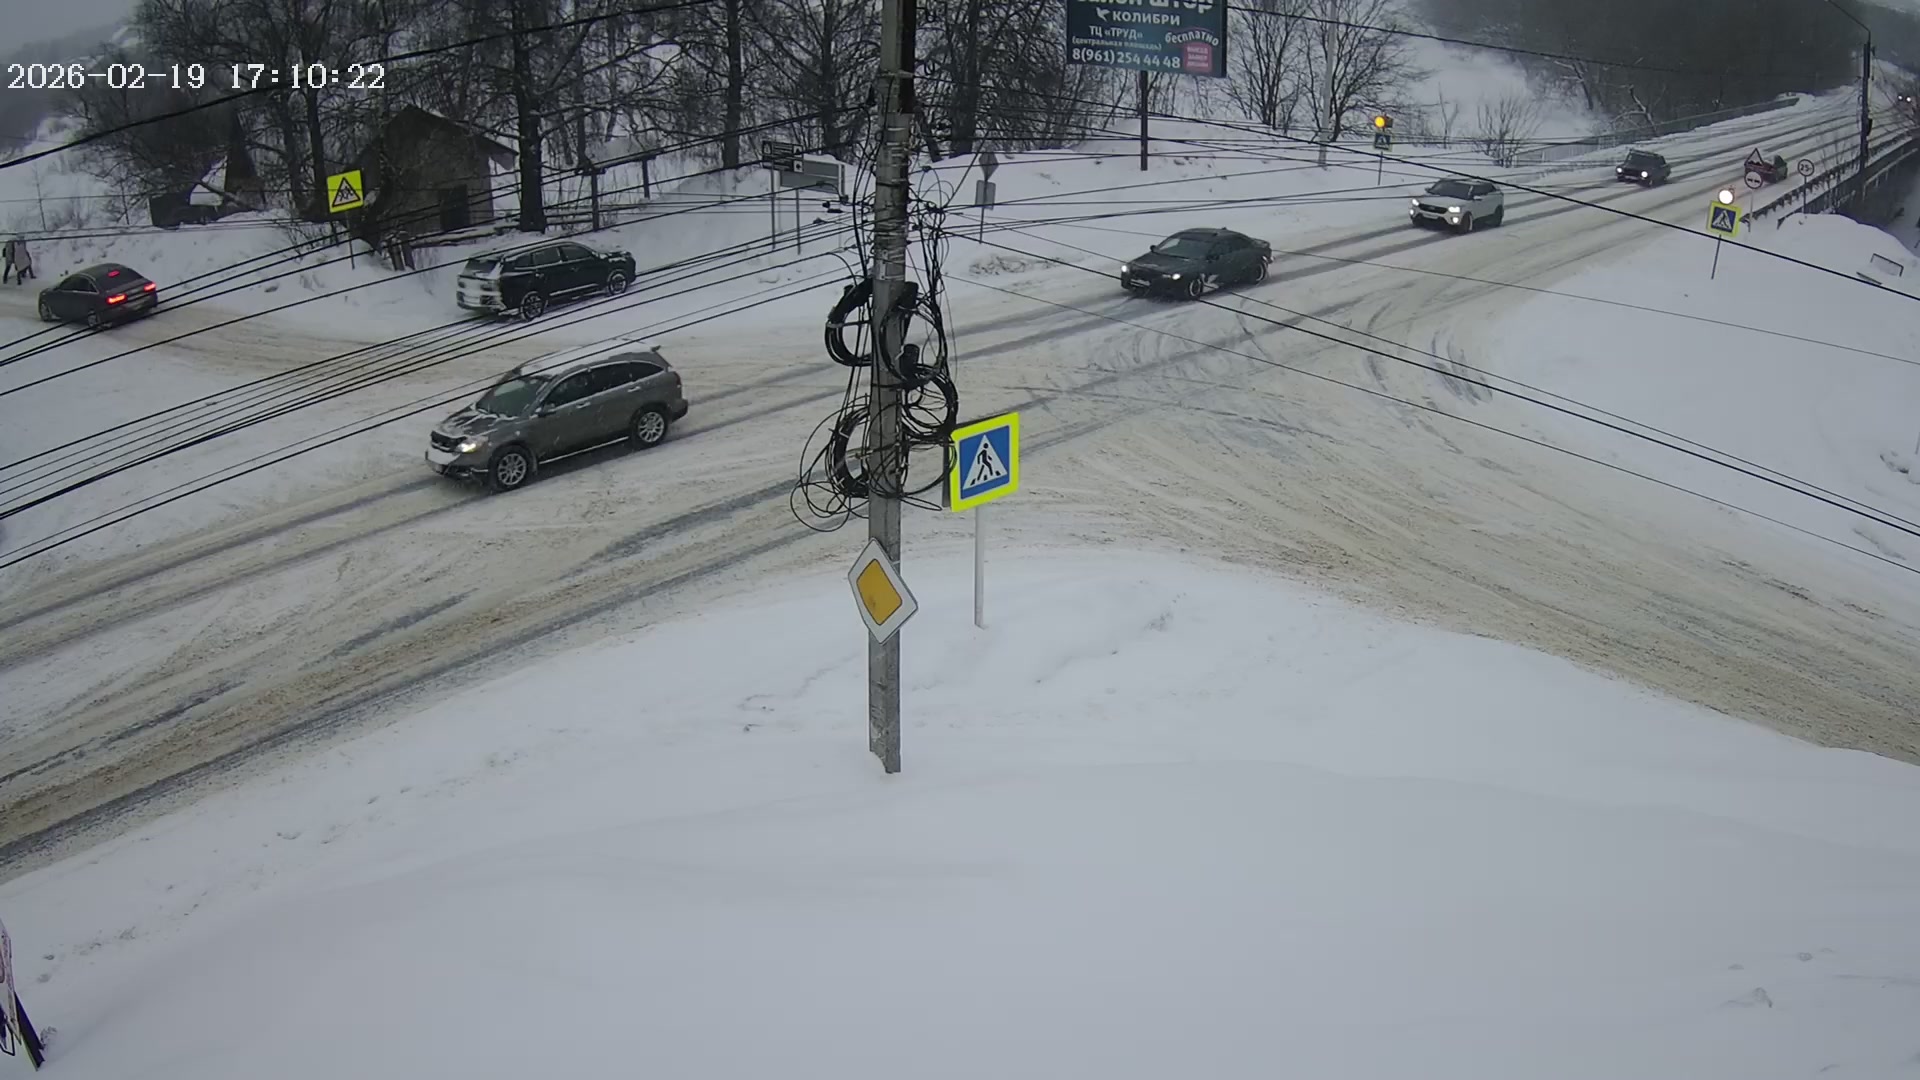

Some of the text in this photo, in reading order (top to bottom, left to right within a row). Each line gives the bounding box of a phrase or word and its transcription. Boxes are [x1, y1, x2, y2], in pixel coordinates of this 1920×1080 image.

[1112, 11, 1181, 25] КОЛИБРИ
[1089, 25, 1103, 38] ТЦ
[1165, 30, 1219, 47] бесплатно
[1072, 47, 1115, 63] 8(961)
[1117, 51, 1141, 64] 254
[1143, 53, 1160, 67] 44
[1163, 55, 1181, 69] 48
